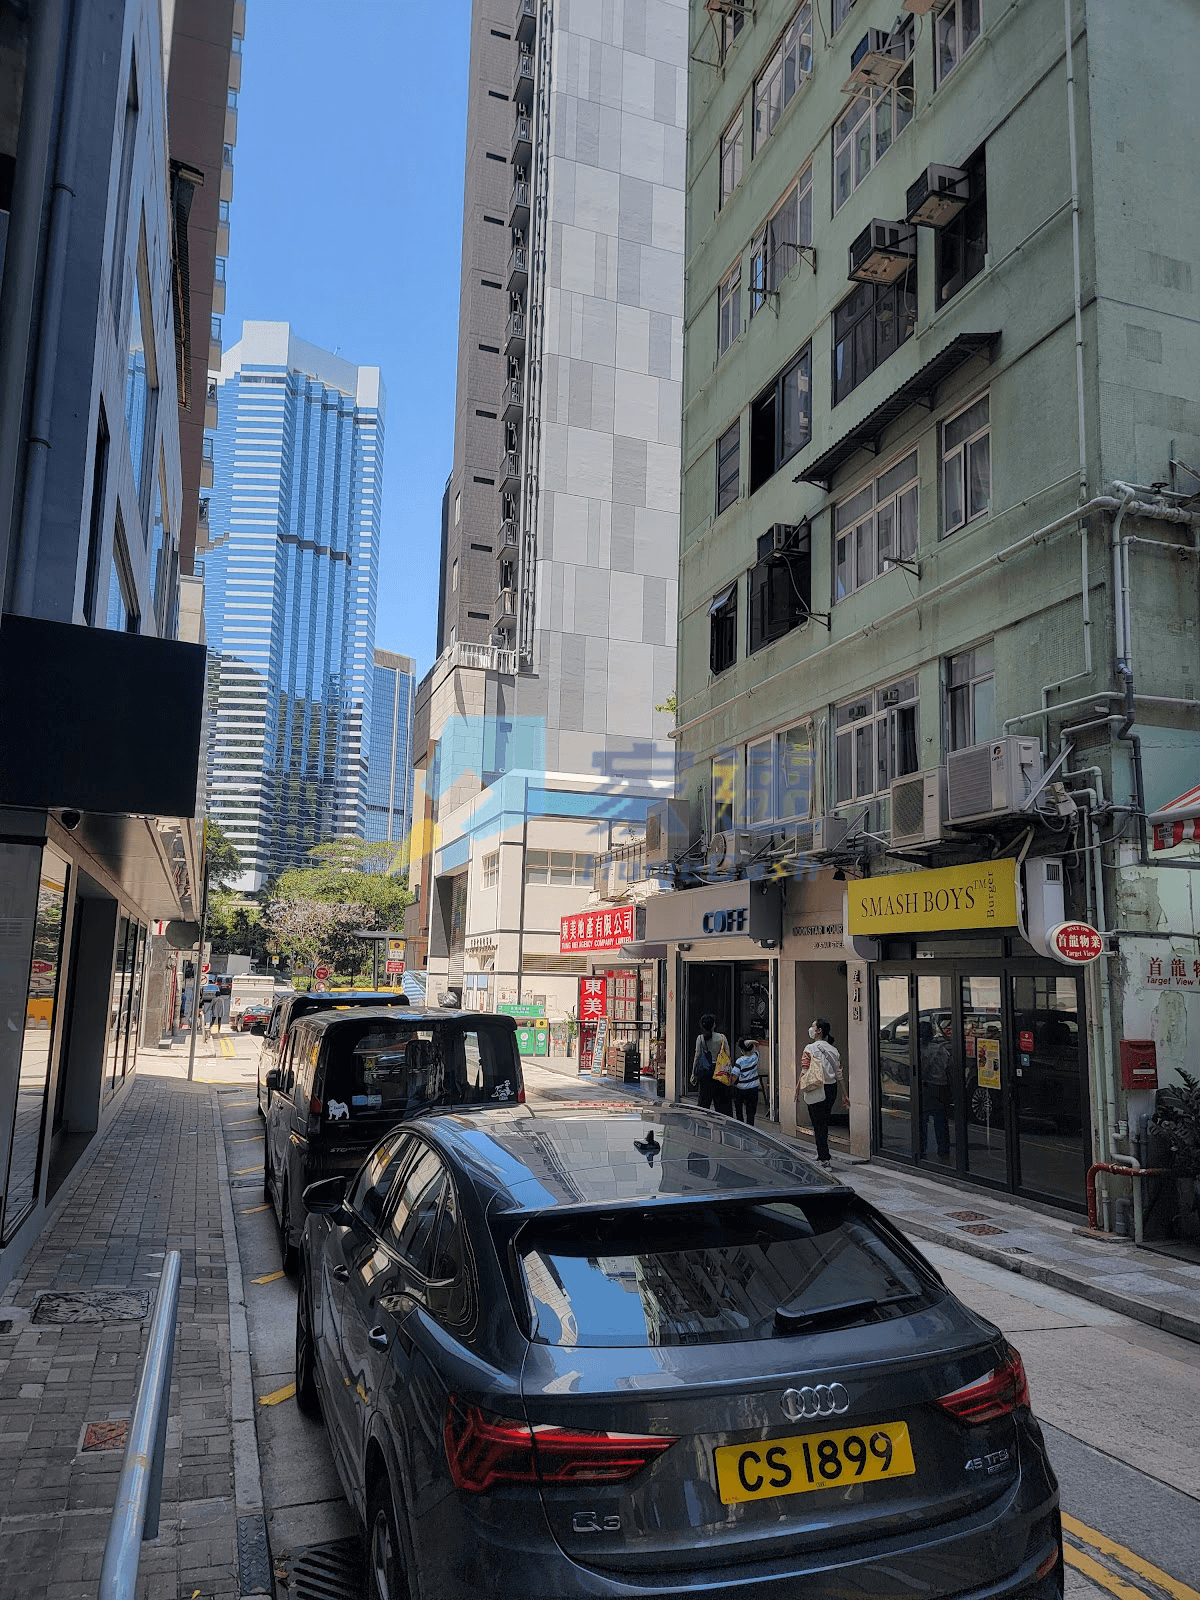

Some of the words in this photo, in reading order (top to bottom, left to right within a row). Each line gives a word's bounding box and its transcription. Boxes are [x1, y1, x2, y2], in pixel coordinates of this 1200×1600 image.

[861, 892, 918, 918] SMASH
[923, 886, 975, 913] BOYS
[986, 871, 997, 919] Burger
[561, 910, 632, 941] 東美地產有限公司
[826, 924, 844, 935] COUR
[594, 938, 614, 947] COMPANY
[1058, 934, 1101, 948] 首龍物業
[1065, 950, 1082, 958] Target
[1146, 975, 1171, 986] Target
[1175, 977, 1195, 986] View
[738, 1446, 792, 1492] CS
[802, 1431, 893, 1483] 1899
[965, 1458, 983, 1470] 45
[573, 1511, 620, 1532] Q3
